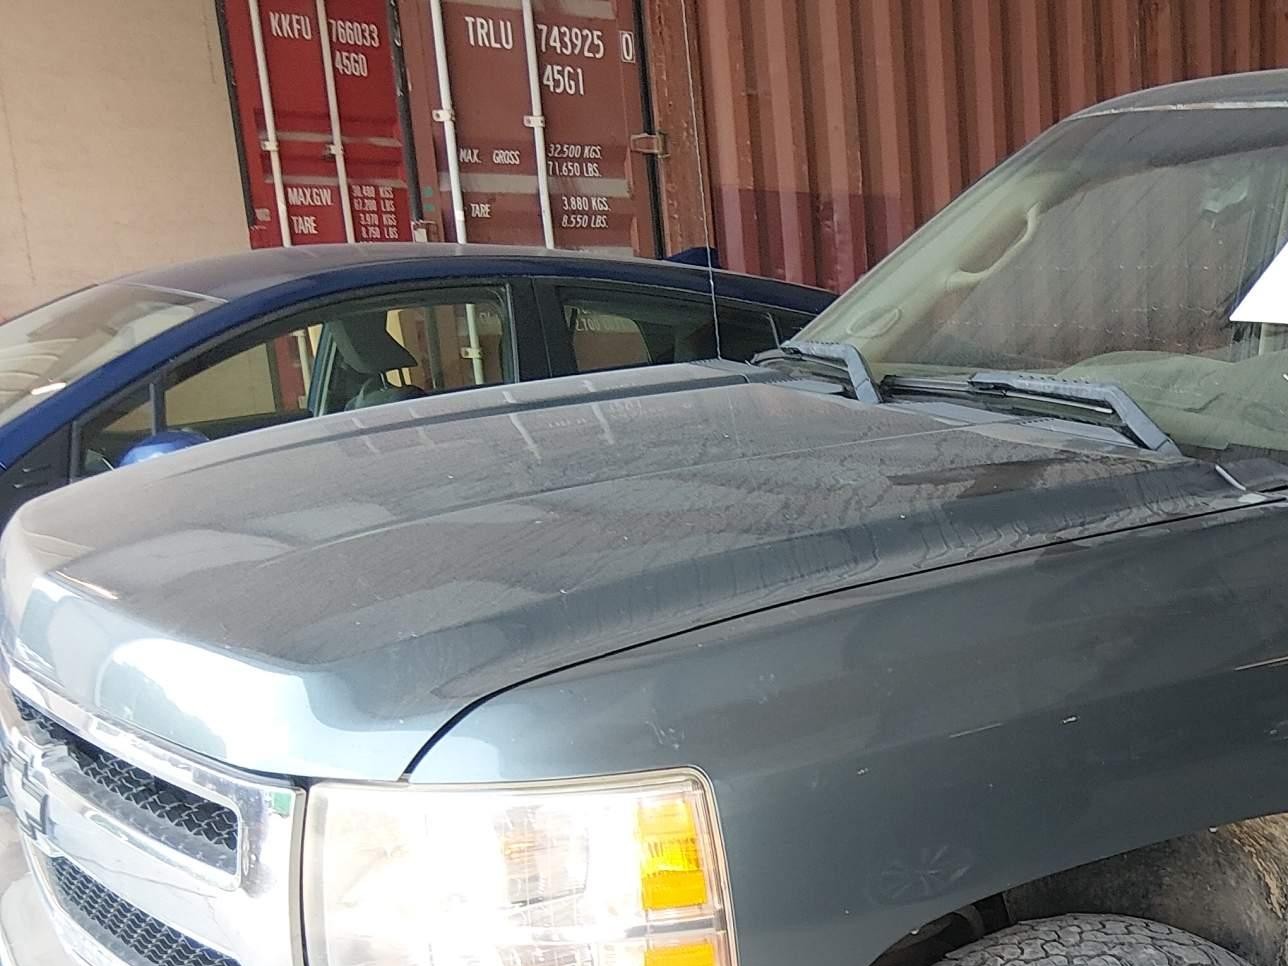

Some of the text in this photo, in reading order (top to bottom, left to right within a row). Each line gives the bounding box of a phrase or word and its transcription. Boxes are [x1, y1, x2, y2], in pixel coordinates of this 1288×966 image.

[269, 11, 380, 48] KKFU 766033
[464, 16, 513, 50] TRLU
[536, 24, 605, 59] 743925
[543, 64, 585, 96] 45G1
[492, 149, 521, 165] GROSS
[548, 161, 602, 177] 71.650 LBS.
[470, 203, 491, 218] TARE
[562, 196, 588, 211] 3.880
[290, 215, 318, 234] TARE
[561, 215, 609, 229] 8.550 LBS.
